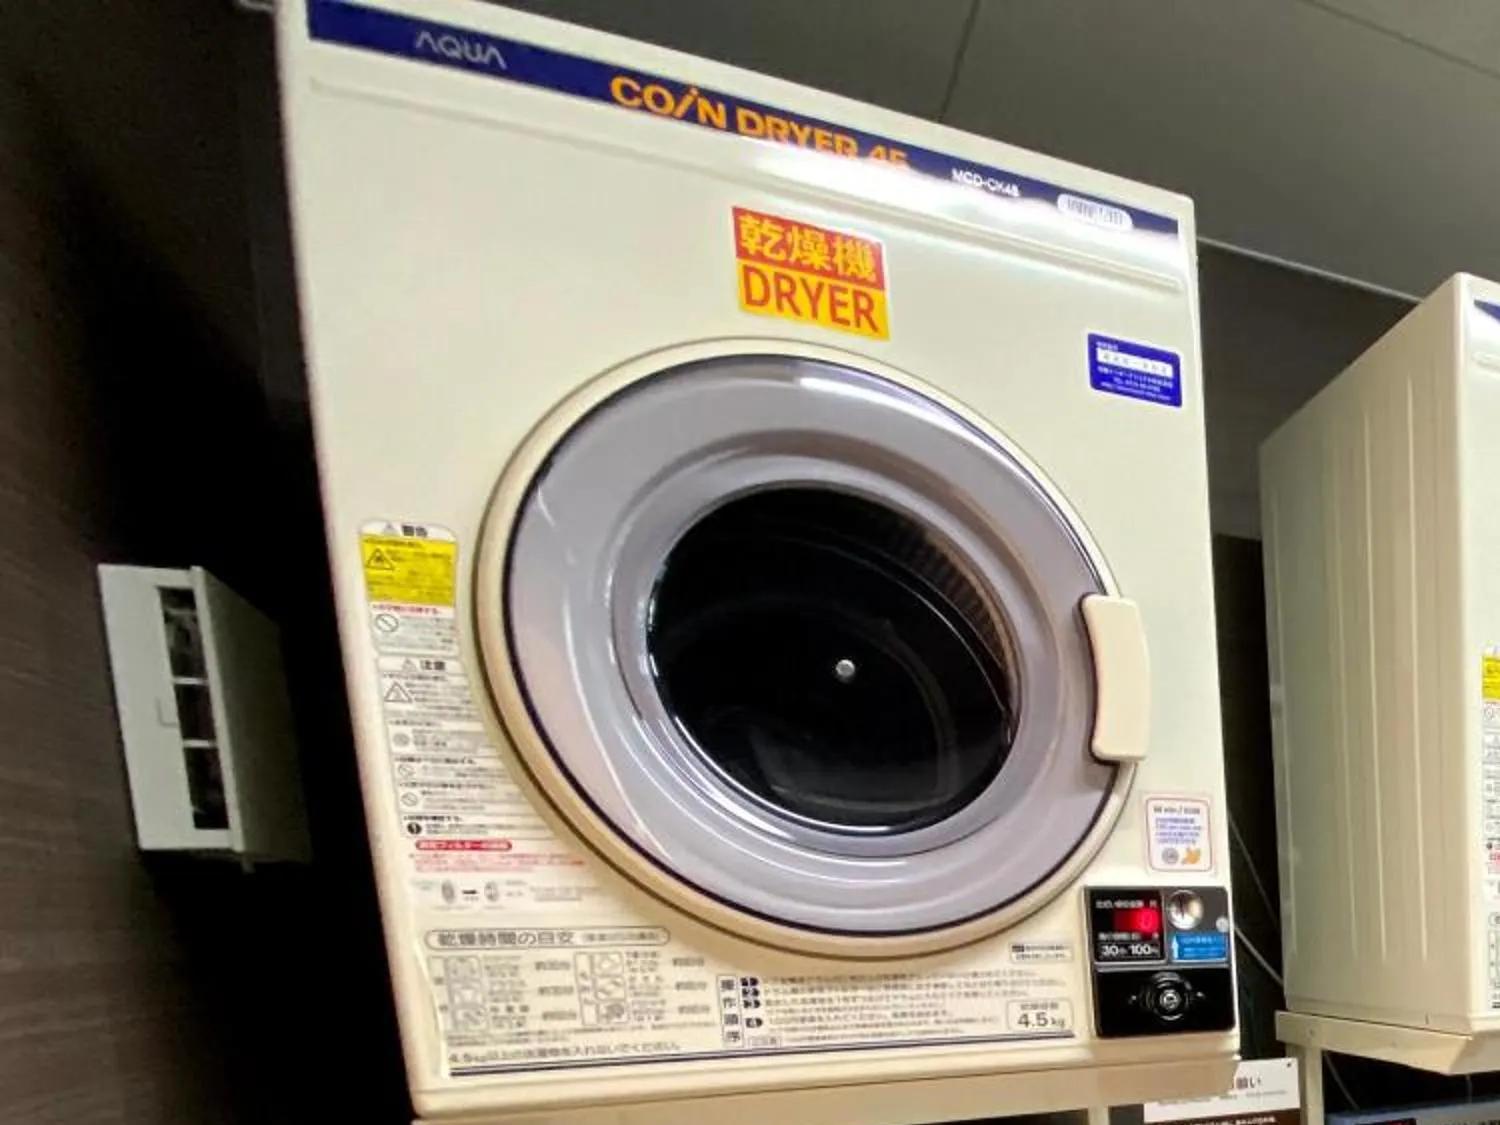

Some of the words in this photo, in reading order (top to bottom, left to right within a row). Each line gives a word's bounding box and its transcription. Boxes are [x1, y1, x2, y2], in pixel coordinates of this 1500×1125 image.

[414, 30, 507, 70] AQUA
[736, 107, 858, 160] DRYER
[739, 213, 877, 280] 乾燥機
[743, 263, 879, 334] DRYER
